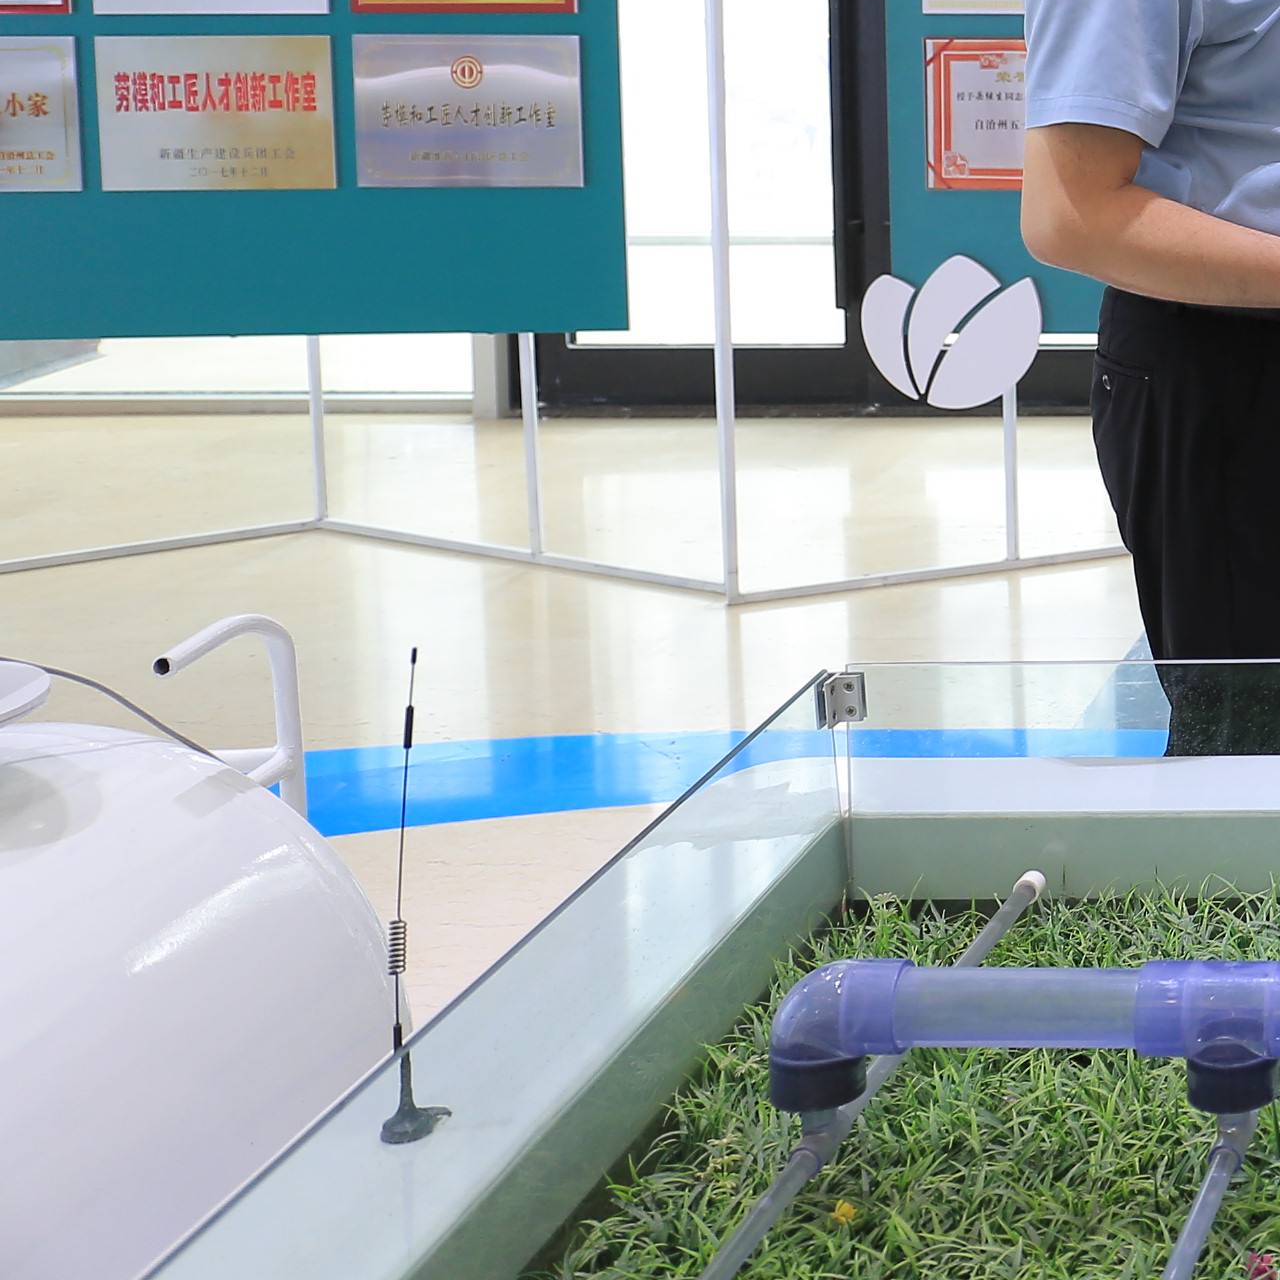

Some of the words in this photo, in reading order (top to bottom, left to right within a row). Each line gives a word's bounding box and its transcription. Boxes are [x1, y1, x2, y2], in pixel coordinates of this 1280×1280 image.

[0, 92, 51, 118] 小家
[114, 71, 318, 113] 劳模和工匠人才创新工作室
[381, 100, 557, 129] 劳模和工匠人才创新工作室
[159, 147, 297, 161] 新疆生产建设兵团工会
